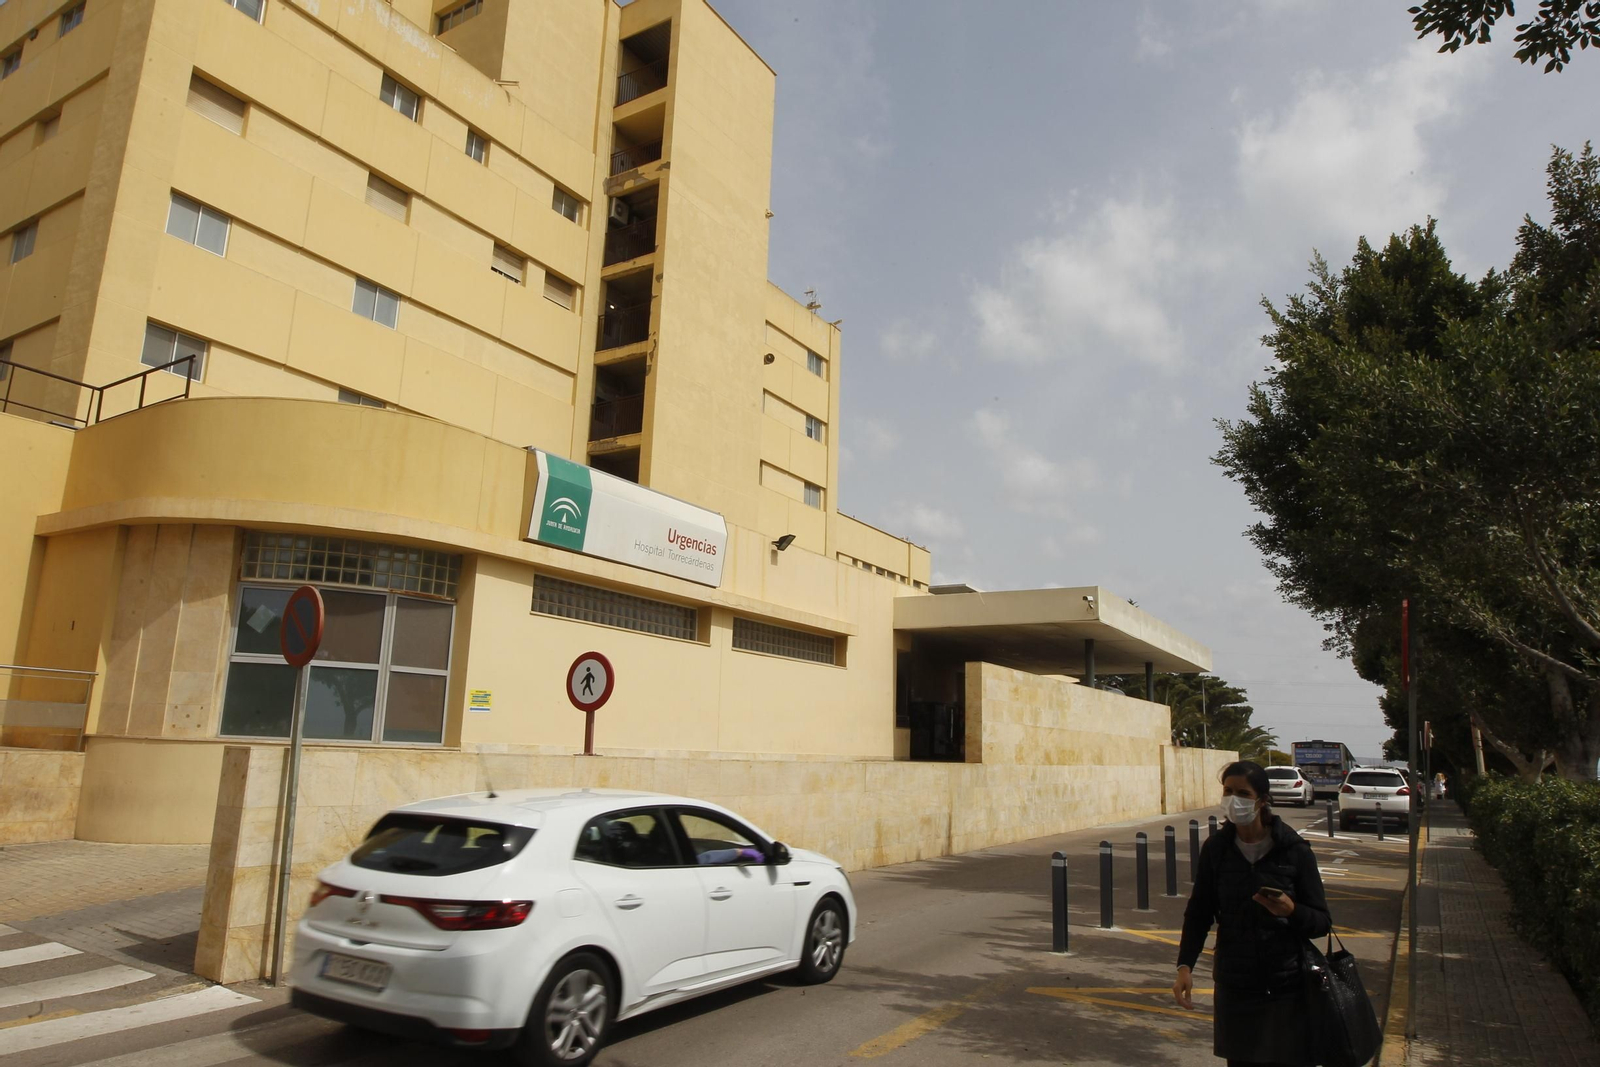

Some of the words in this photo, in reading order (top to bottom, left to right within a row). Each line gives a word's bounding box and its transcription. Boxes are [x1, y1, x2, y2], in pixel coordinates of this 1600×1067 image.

[634, 540, 665, 556] Hospital
[668, 549, 715, 571] Torrecárdenas
[668, 528, 716, 556] Urgencias
